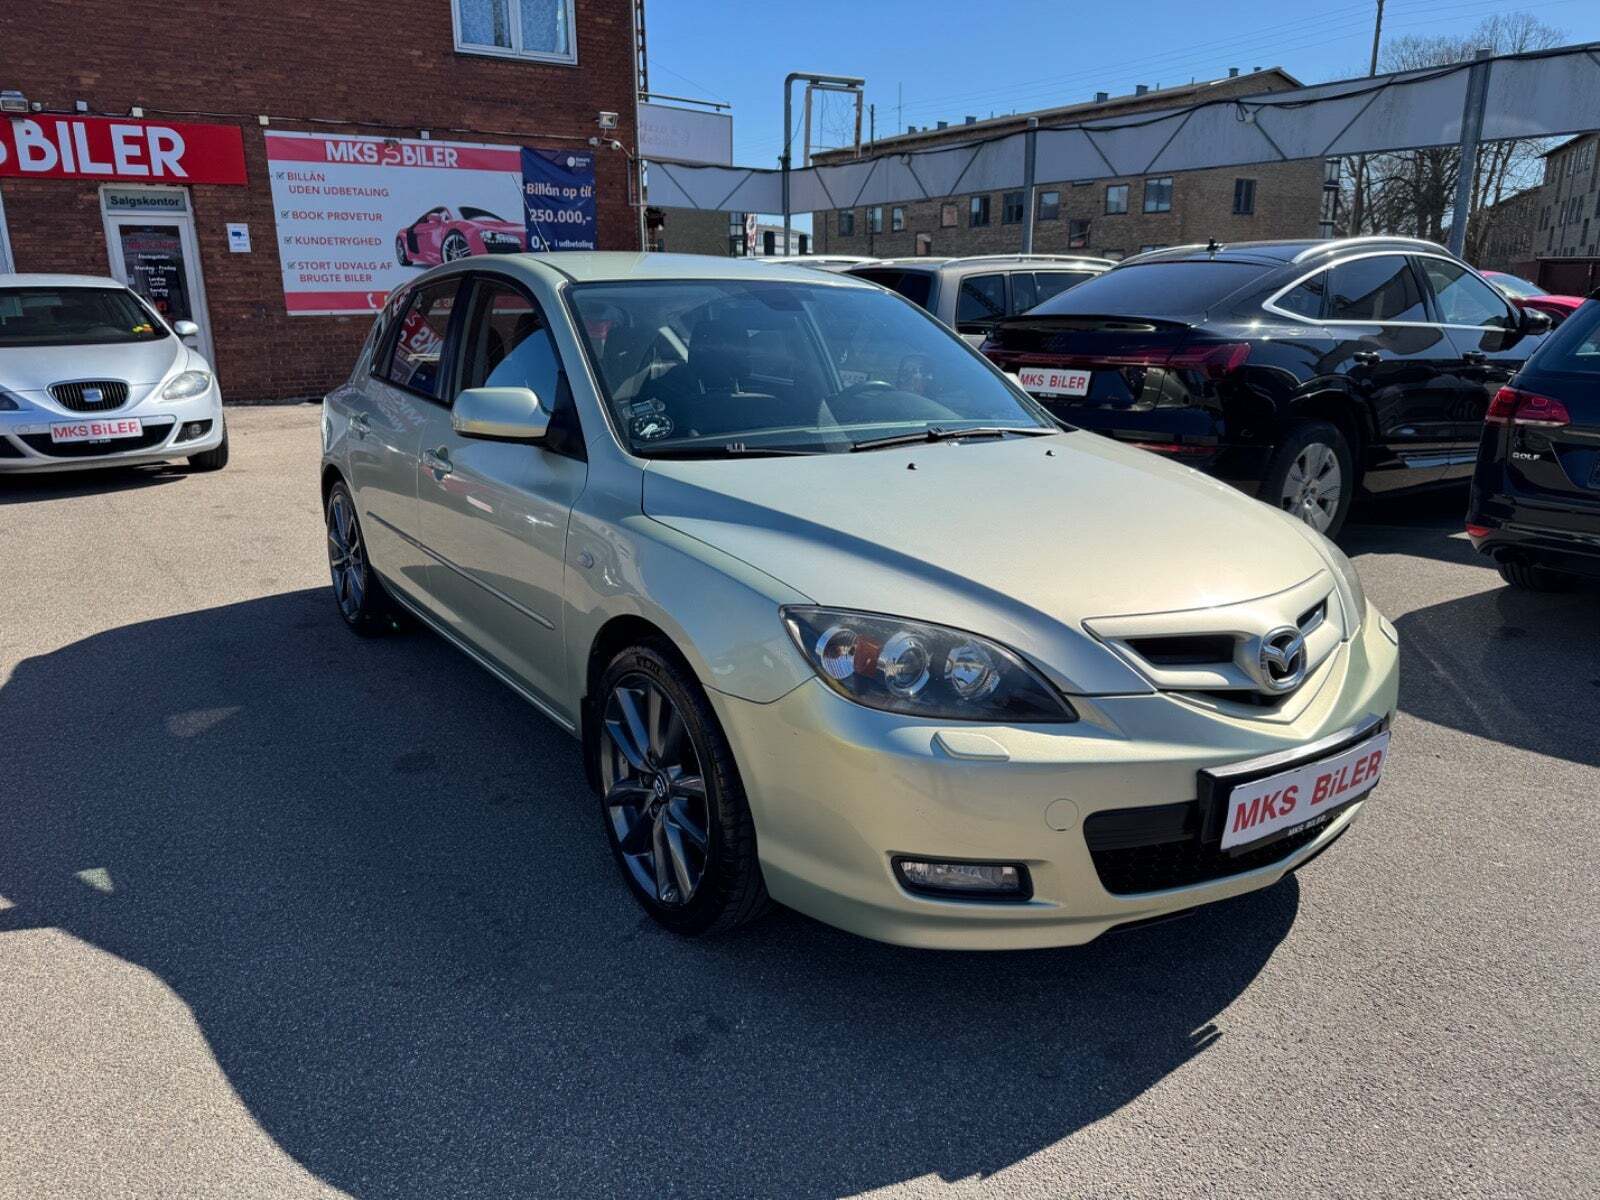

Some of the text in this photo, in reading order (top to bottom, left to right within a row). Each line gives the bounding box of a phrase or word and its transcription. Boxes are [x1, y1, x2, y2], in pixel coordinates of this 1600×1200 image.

[12, 119, 189, 178] BILER
[325, 141, 459, 168] MKS BILER
[287, 171, 325, 183] BILLÅN
[289, 185, 389, 198] UDEN UDBETALING
[526, 183, 592, 200] Billån op til
[110, 195, 181, 207] Salgskontor
[291, 210, 383, 222] BOOK PRØVETUR
[530, 208, 592, 226] 250.000,-
[295, 235, 382, 246] KUNDETRYGHED
[559, 239, 594, 250] udbetaling
[298, 261, 393, 271] STORT UDVALG AF
[300, 273, 373, 283] BRUGTE BILER
[1020, 374, 1045, 387] MKS
[53, 424, 88, 438] MKS
[1512, 451, 1541, 461] GOLF
[1232, 750, 1382, 833] MKS BiLER
